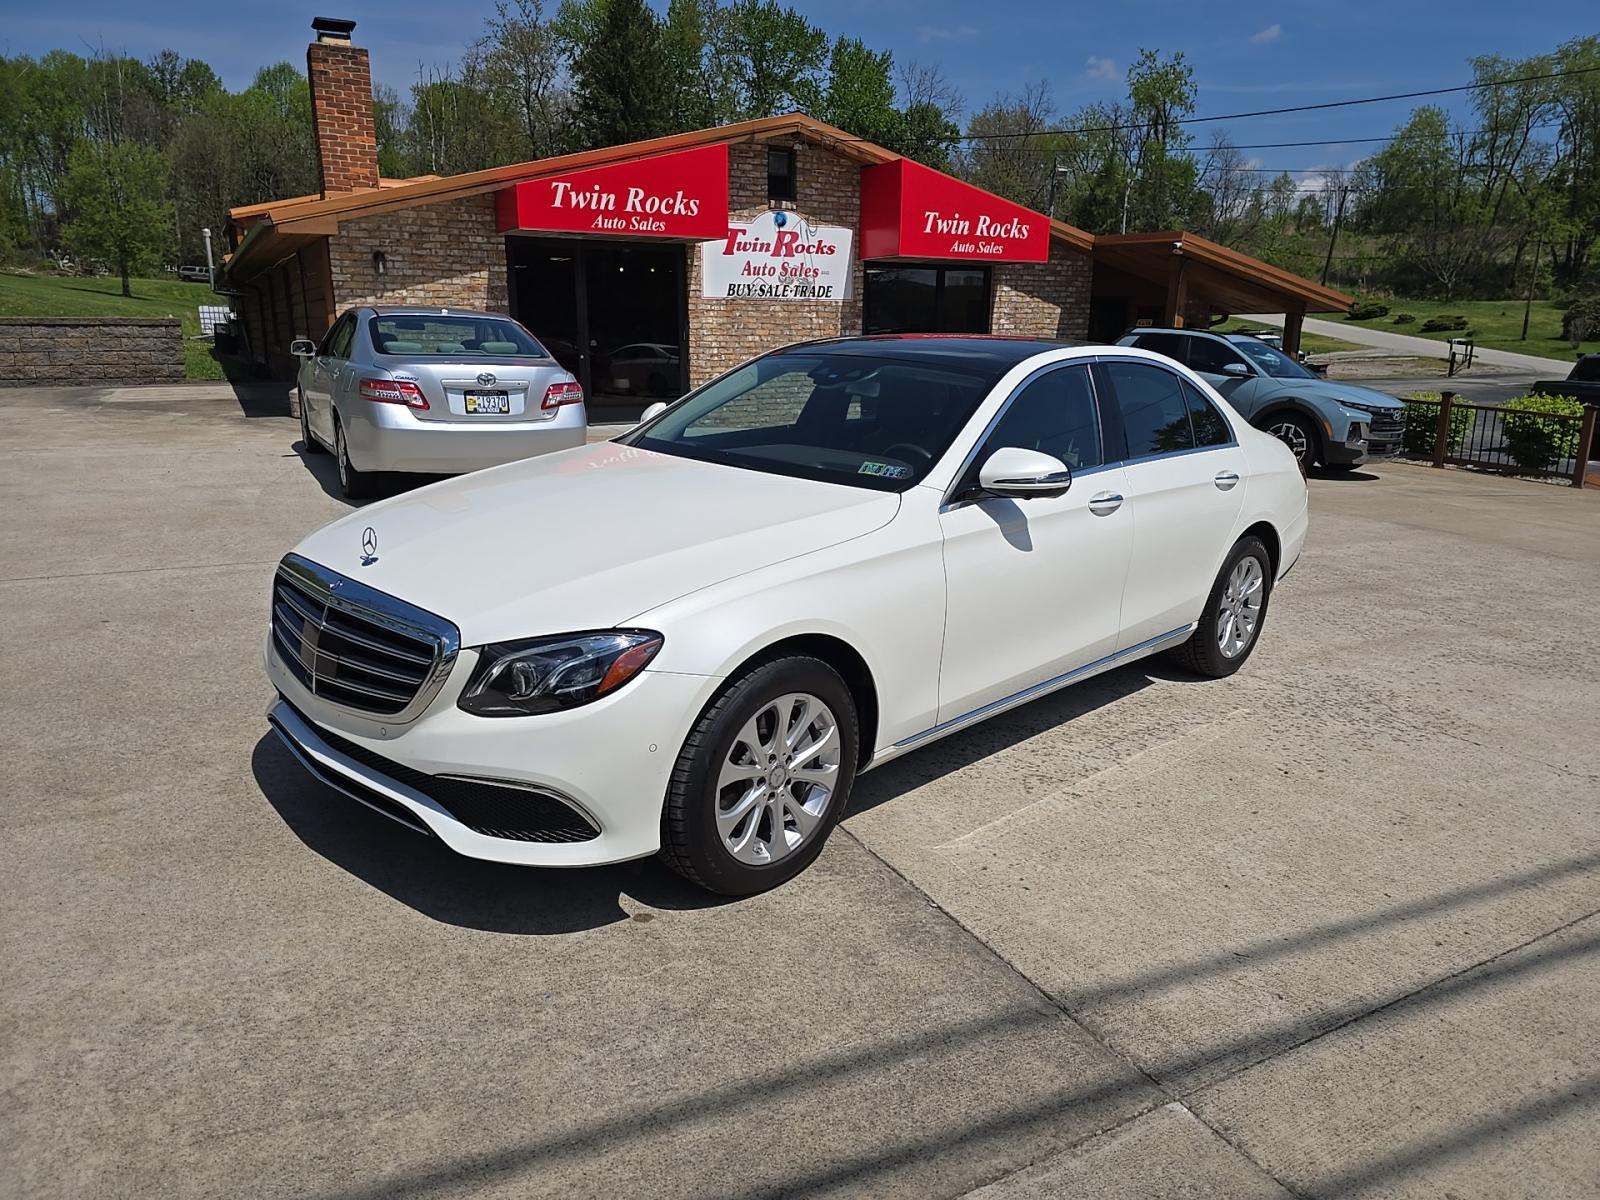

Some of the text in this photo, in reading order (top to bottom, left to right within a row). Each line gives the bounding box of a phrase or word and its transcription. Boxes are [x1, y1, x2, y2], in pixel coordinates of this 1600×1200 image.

[551, 182, 700, 216] Twin Rocks
[591, 214, 666, 231] Auto Sales
[923, 211, 1030, 240] Twin Rocks
[722, 228, 836, 257] Twin Rocks
[950, 240, 1004, 254] Auto Sales
[741, 260, 820, 278] Auto Sales
